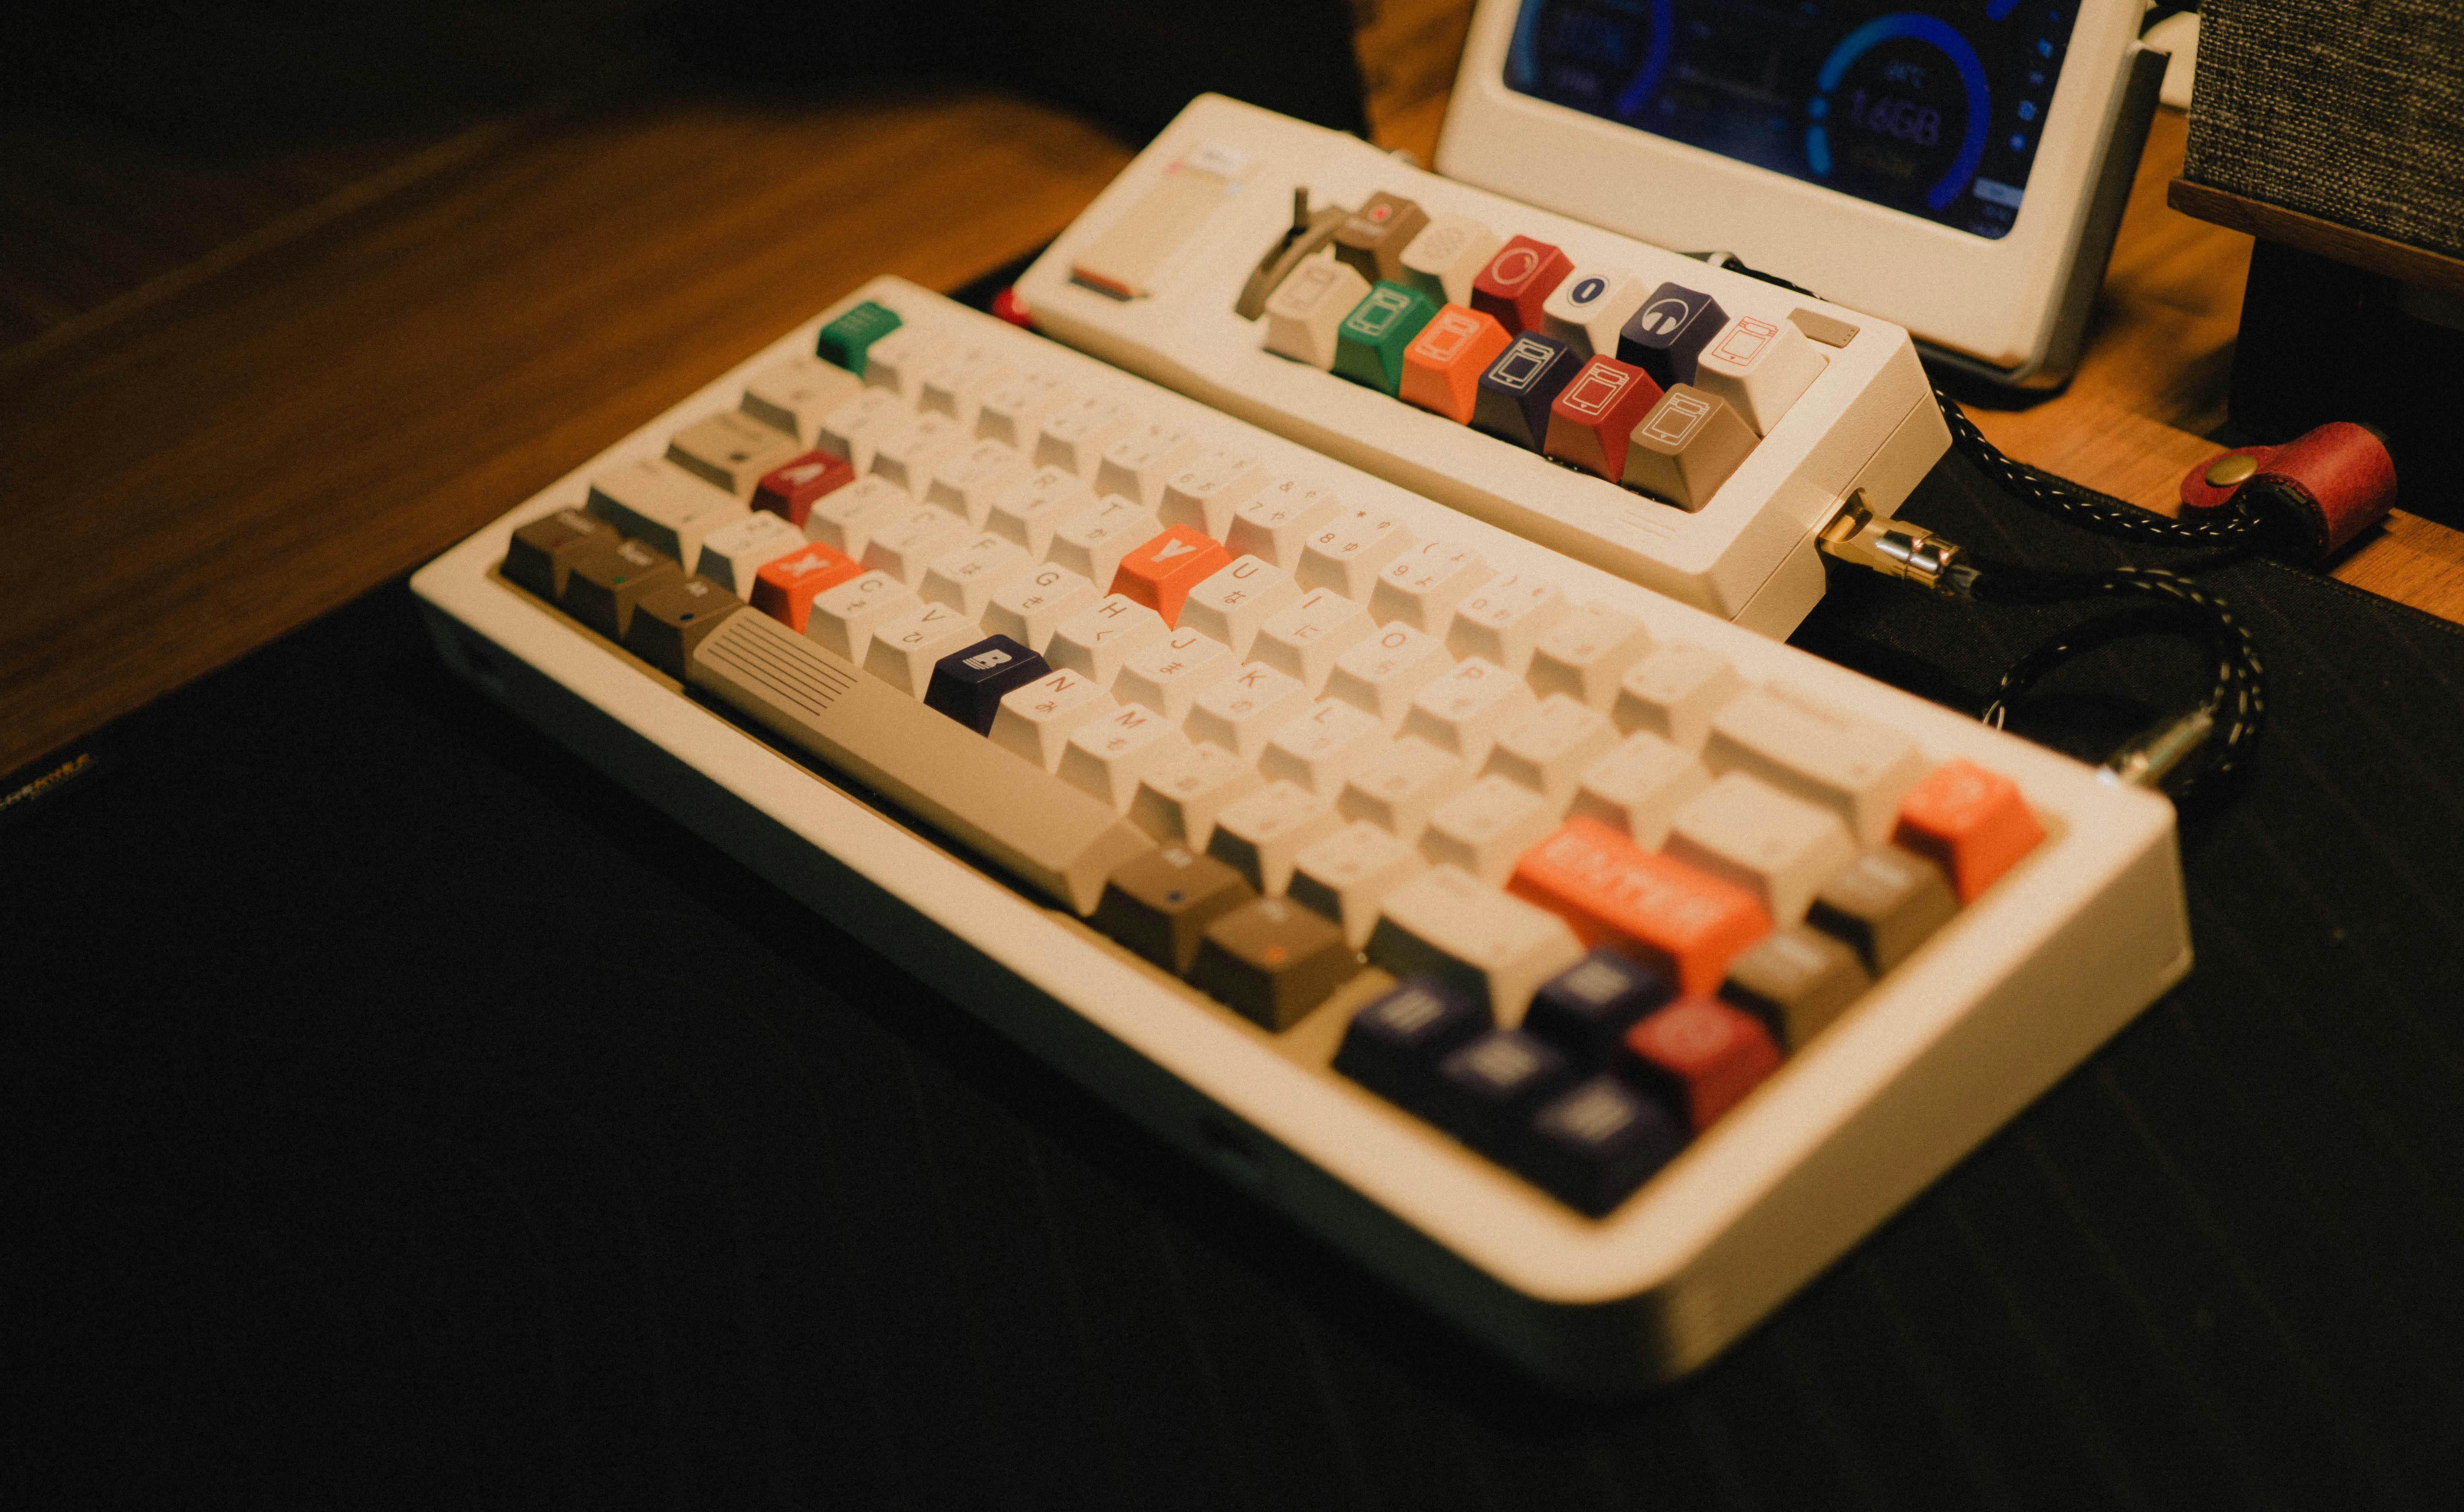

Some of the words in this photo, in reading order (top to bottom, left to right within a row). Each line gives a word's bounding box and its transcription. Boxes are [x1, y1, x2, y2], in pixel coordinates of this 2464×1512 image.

[1179, 474, 1195, 484] 6
[1279, 481, 1295, 492] &
[1101, 504, 1123, 516] T
[1248, 502, 1264, 511] 7
[1319, 533, 1335, 543] 8
[1343, 543, 1358, 552] ゆ
[1151, 538, 1197, 563] Y
[778, 552, 830, 576] X
[1232, 562, 1259, 579] U
[1036, 572, 1060, 587] G
[1393, 565, 1409, 576] 9
[1415, 576, 1433, 587] よ
[860, 579, 883, 593] C
[1023, 596, 1044, 608] き
[1224, 590, 1246, 605] な
[1302, 596, 1322, 609] I
[922, 609, 944, 623] V
[1099, 602, 1127, 618] H
[1293, 624, 1319, 639] に
[1171, 638, 1197, 649] J
[962, 649, 1012, 670] B
[1160, 661, 1185, 675] ま
[1046, 676, 1076, 693] N
[1238, 670, 1268, 688] K
[1035, 700, 1058, 713] み
[1115, 711, 1147, 729] M
[1314, 707, 1333, 724] L
